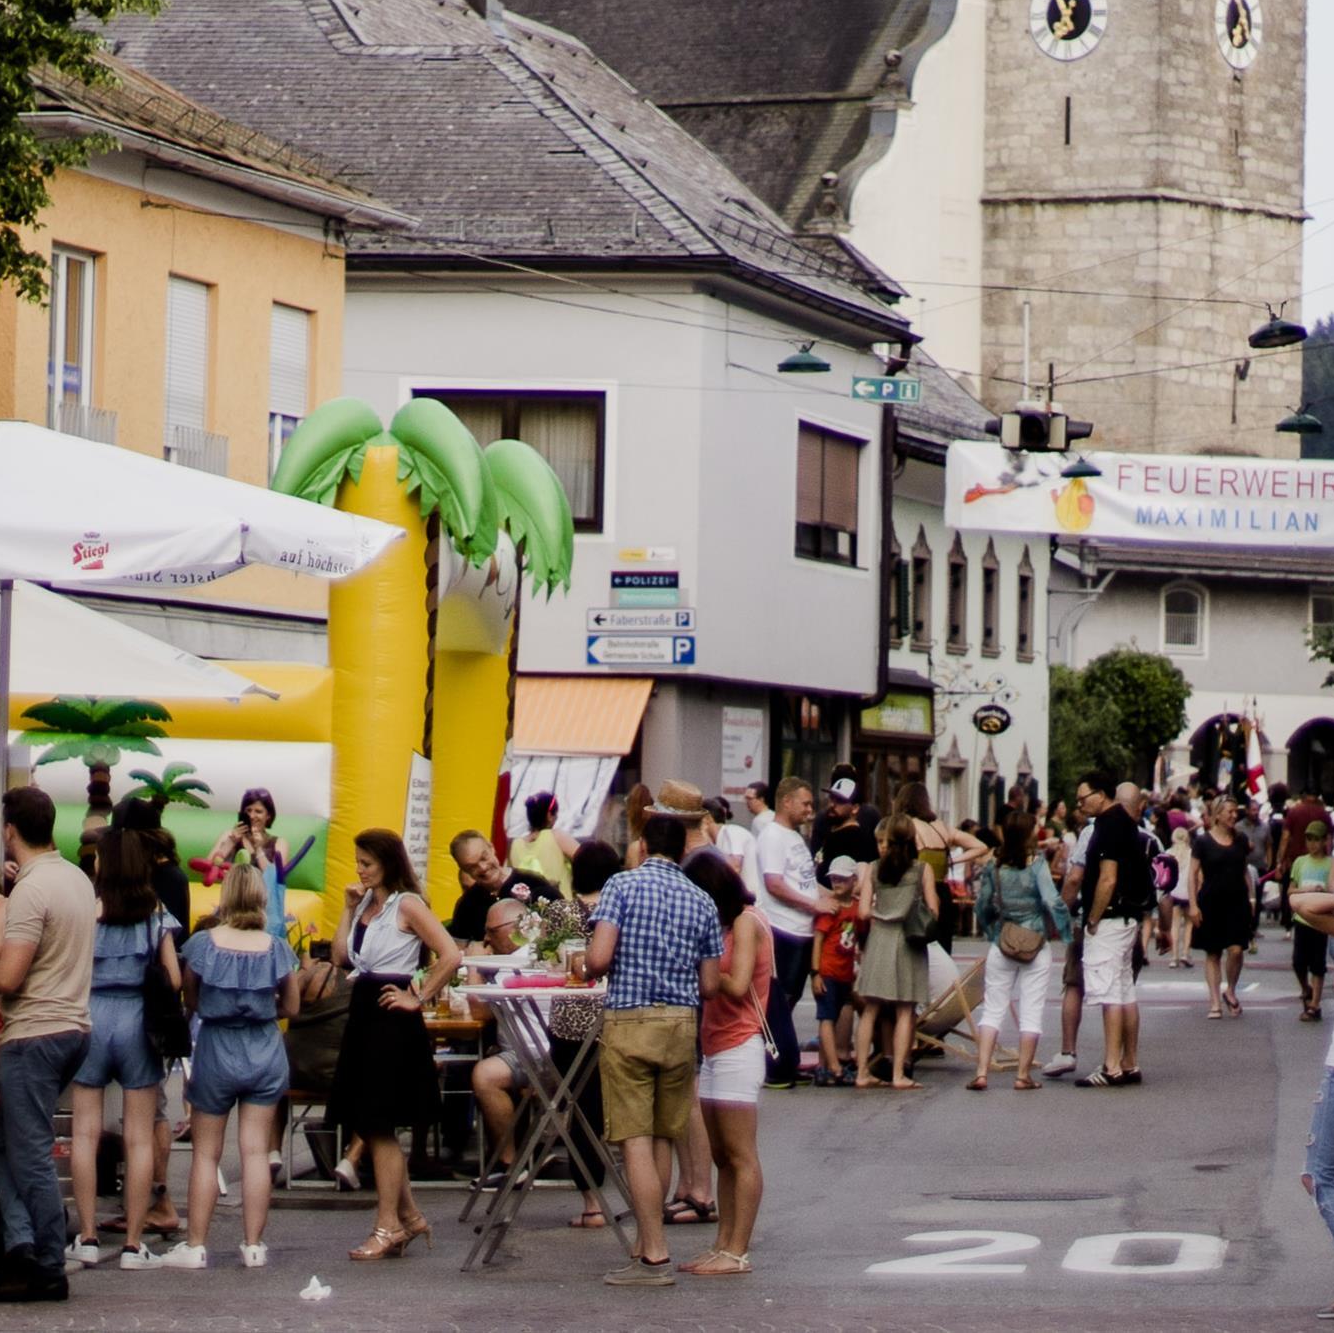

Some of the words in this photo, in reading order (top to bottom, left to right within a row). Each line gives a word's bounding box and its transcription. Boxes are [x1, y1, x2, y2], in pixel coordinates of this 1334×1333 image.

[1136, 505, 1320, 532] MAXIMILIAN
[72, 542, 109, 565] Stiegl
[279, 548, 304, 565] auf
[625, 576, 670, 585] POLIZEI
[610, 614, 672, 626] Faberstraße
[678, 613, 688, 626] P
[674, 637, 692, 662] P
[864, 1229, 1230, 1275] 20
